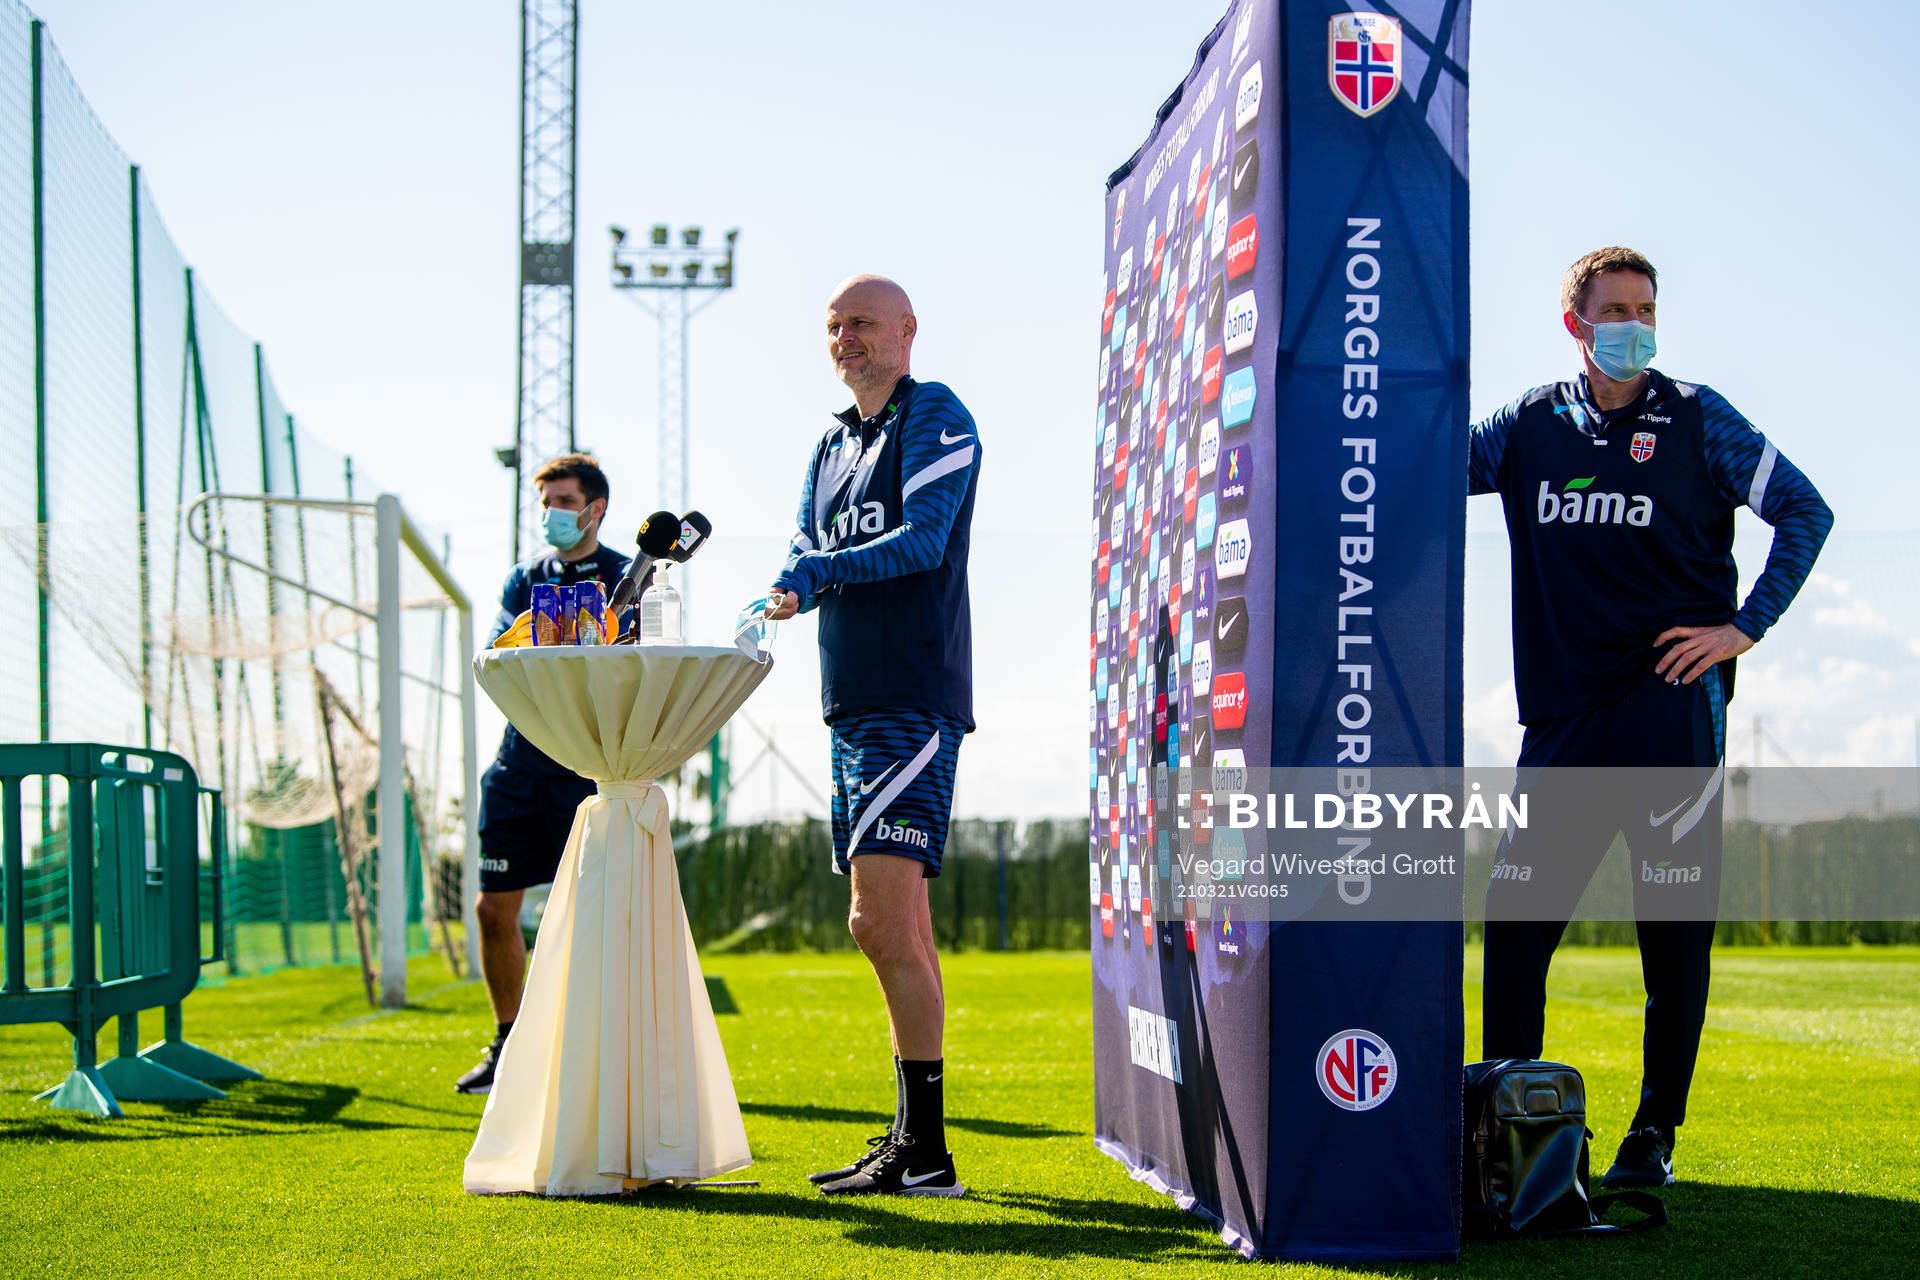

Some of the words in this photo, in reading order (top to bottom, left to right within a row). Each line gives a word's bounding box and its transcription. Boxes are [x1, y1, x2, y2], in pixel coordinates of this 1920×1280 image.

[1227, 309, 1253, 341] bama
[1343, 217, 1381, 419] NORGES
[1647, 413, 1672, 424] Tipping
[1537, 480, 1653, 527] bama
[1218, 535, 1246, 565] bama
[1336, 437, 1376, 905] FOTBALLFORBUND
[1213, 690, 1237, 713] equinor
[1215, 761, 1243, 792] bama
[876, 817, 928, 849] bama
[1641, 860, 1701, 884] bama
